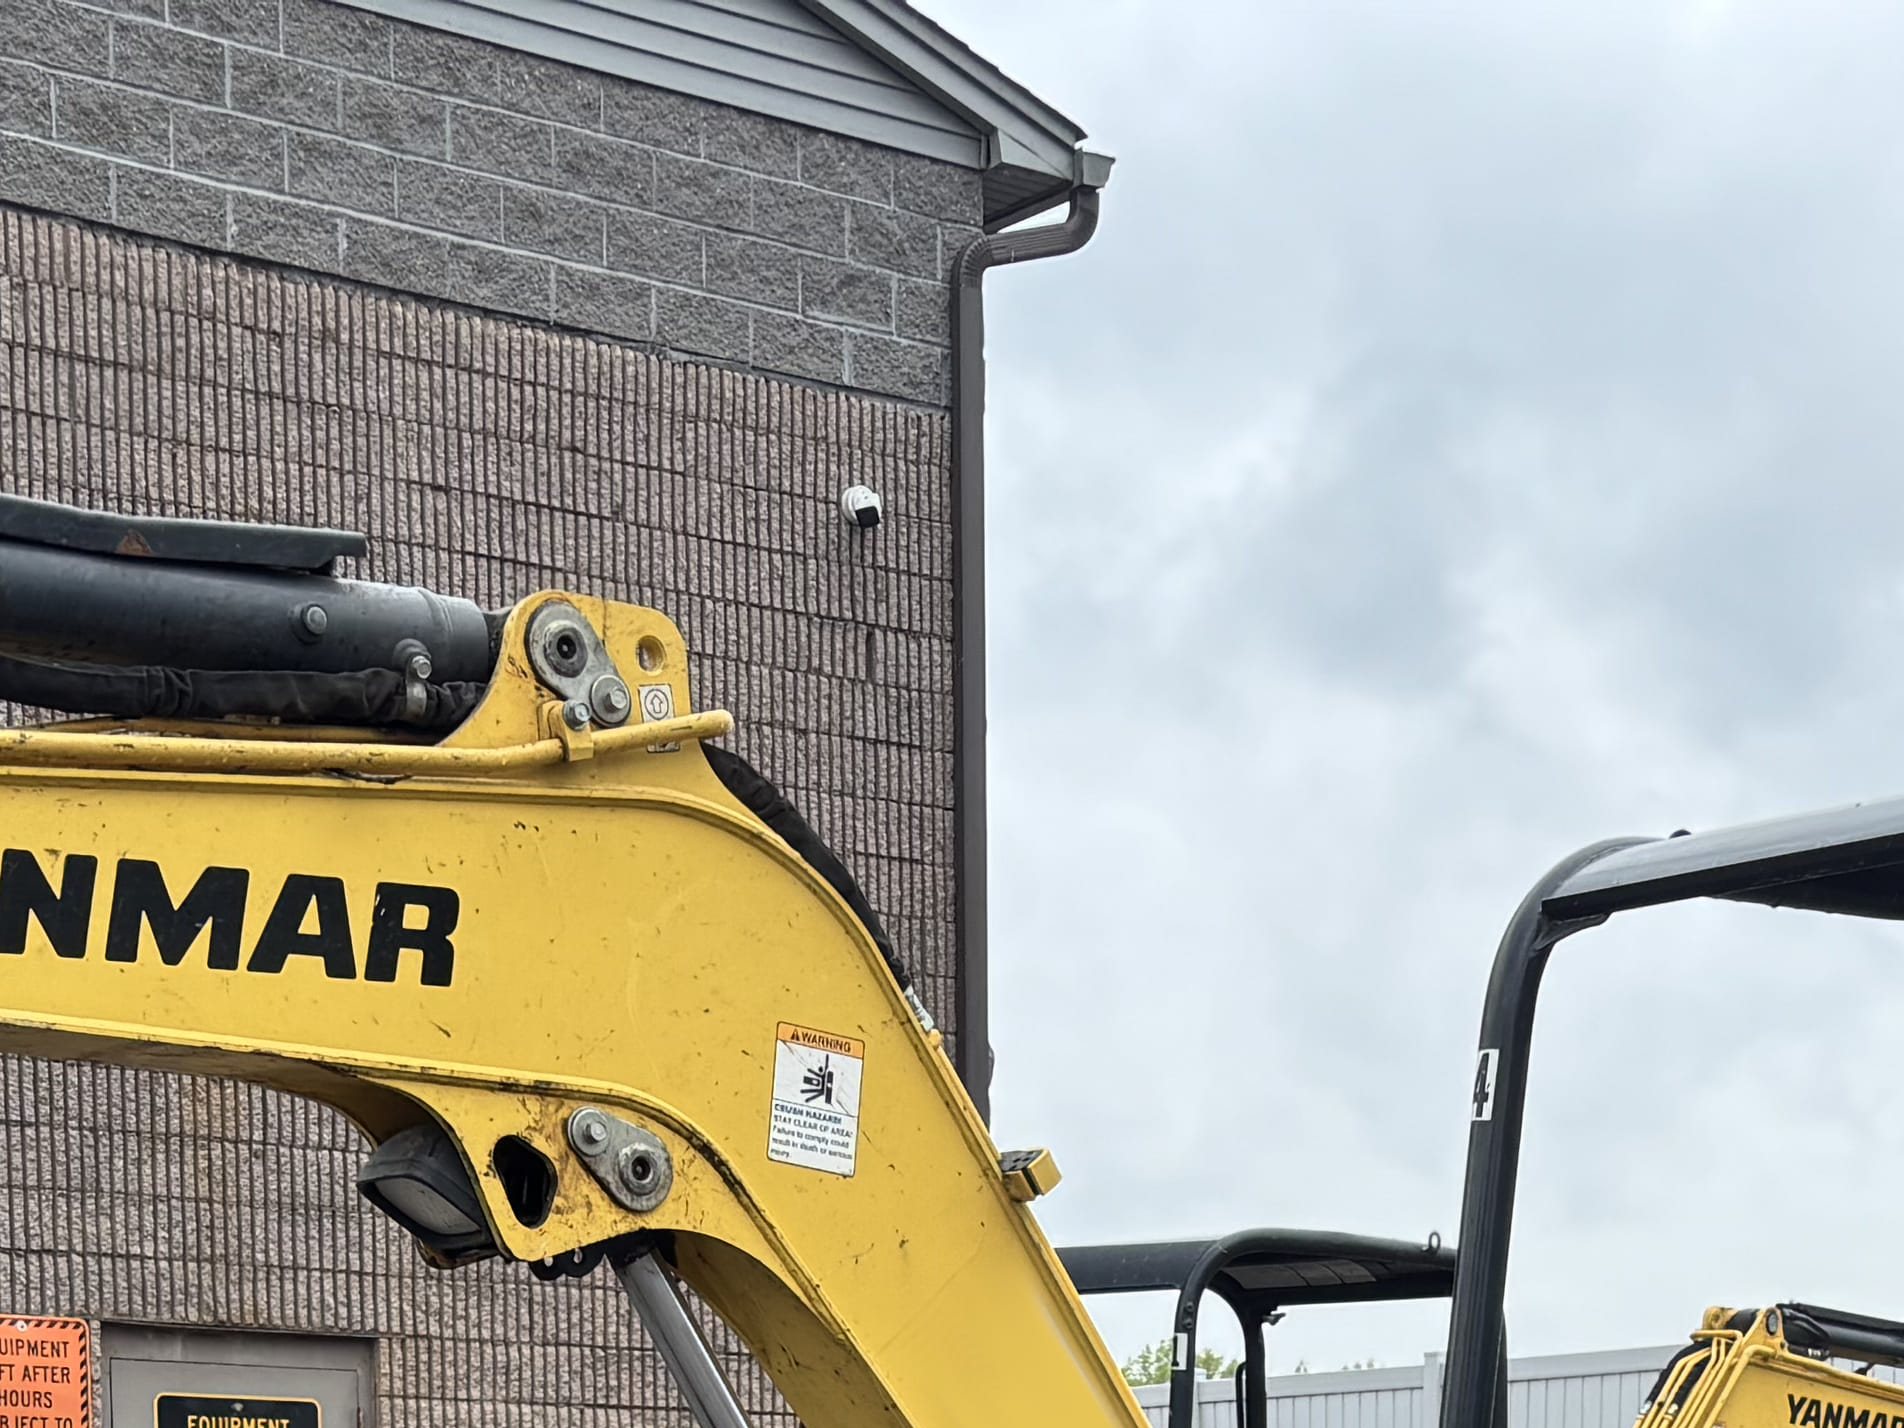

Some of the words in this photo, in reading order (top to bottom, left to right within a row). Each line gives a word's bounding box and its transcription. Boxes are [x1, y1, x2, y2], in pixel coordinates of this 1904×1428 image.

[802, 1032, 851, 1053] WARNING
[1472, 1051, 1490, 1119] 4
[794, 1119, 817, 1130] CLEAR
[22, 1365, 71, 1384] AFTER
